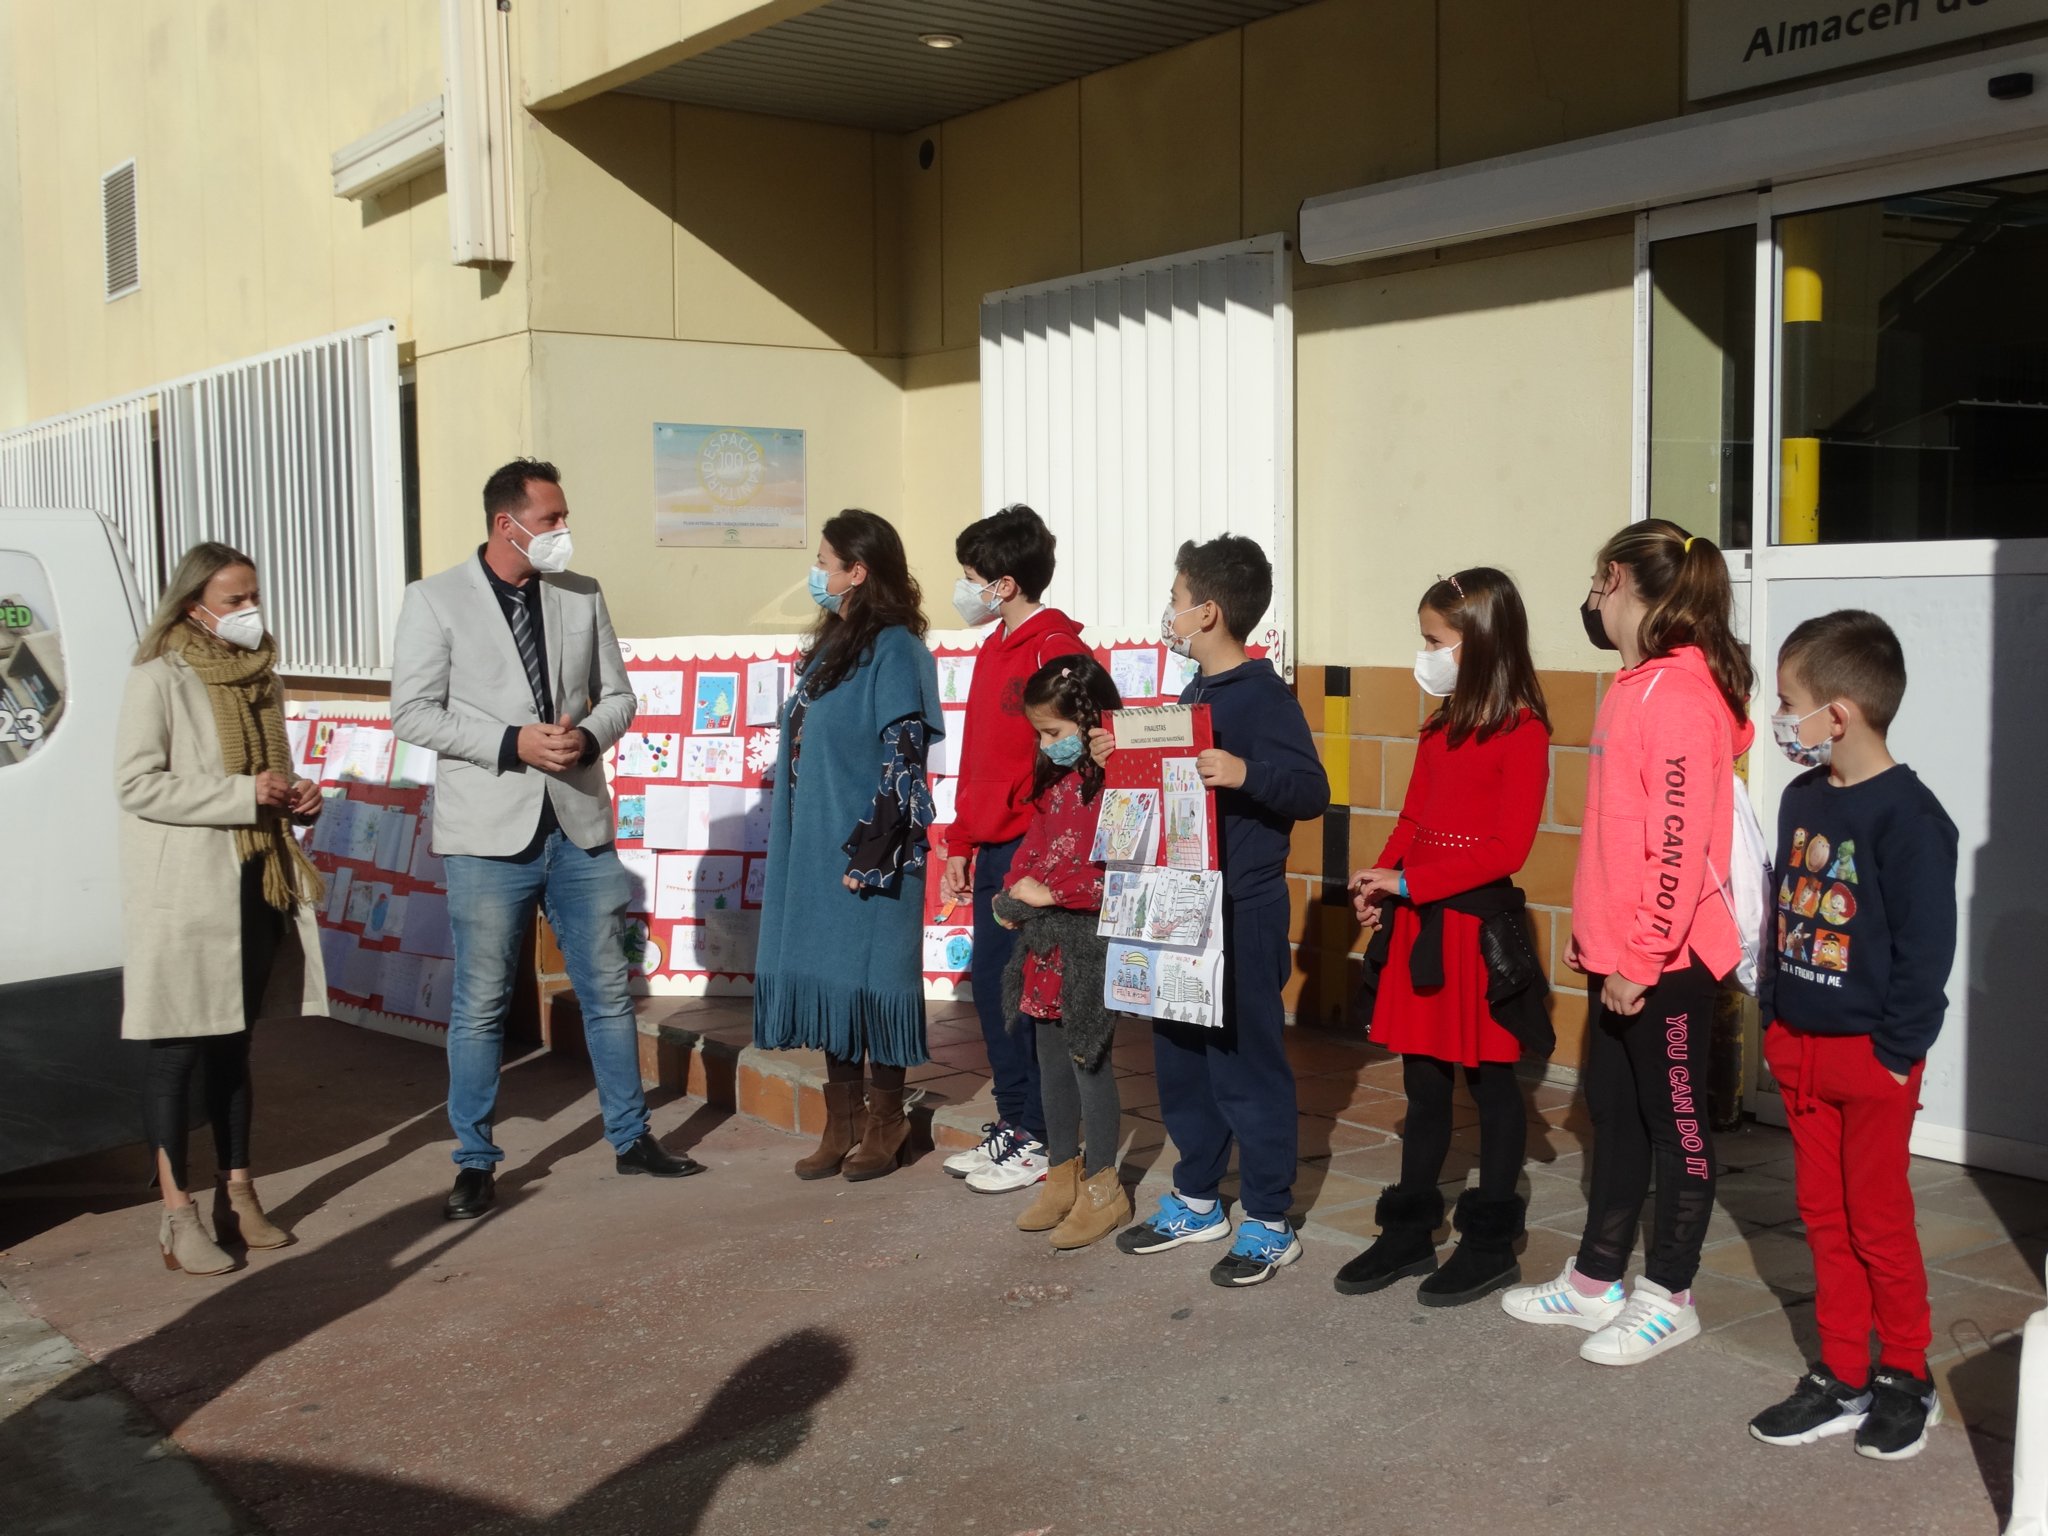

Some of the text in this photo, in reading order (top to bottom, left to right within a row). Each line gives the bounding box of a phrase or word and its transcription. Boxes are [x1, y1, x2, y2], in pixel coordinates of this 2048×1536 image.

[703, 432, 761, 462] ESPACIO
[1652, 756, 1686, 938] YOU CAN DO IT
[1794, 966, 1815, 981] FRIEND
[1816, 973, 1825, 984] IN
[1827, 975, 1842, 988] ME.
[1666, 1013, 1688, 1060] YOU
[1668, 1066, 1695, 1113] CAN
[1676, 1118, 1704, 1153] DO
[1685, 1156, 1709, 1179] IT
[1810, 1373, 1827, 1387] FILA
[1875, 1375, 1893, 1384] FILA
